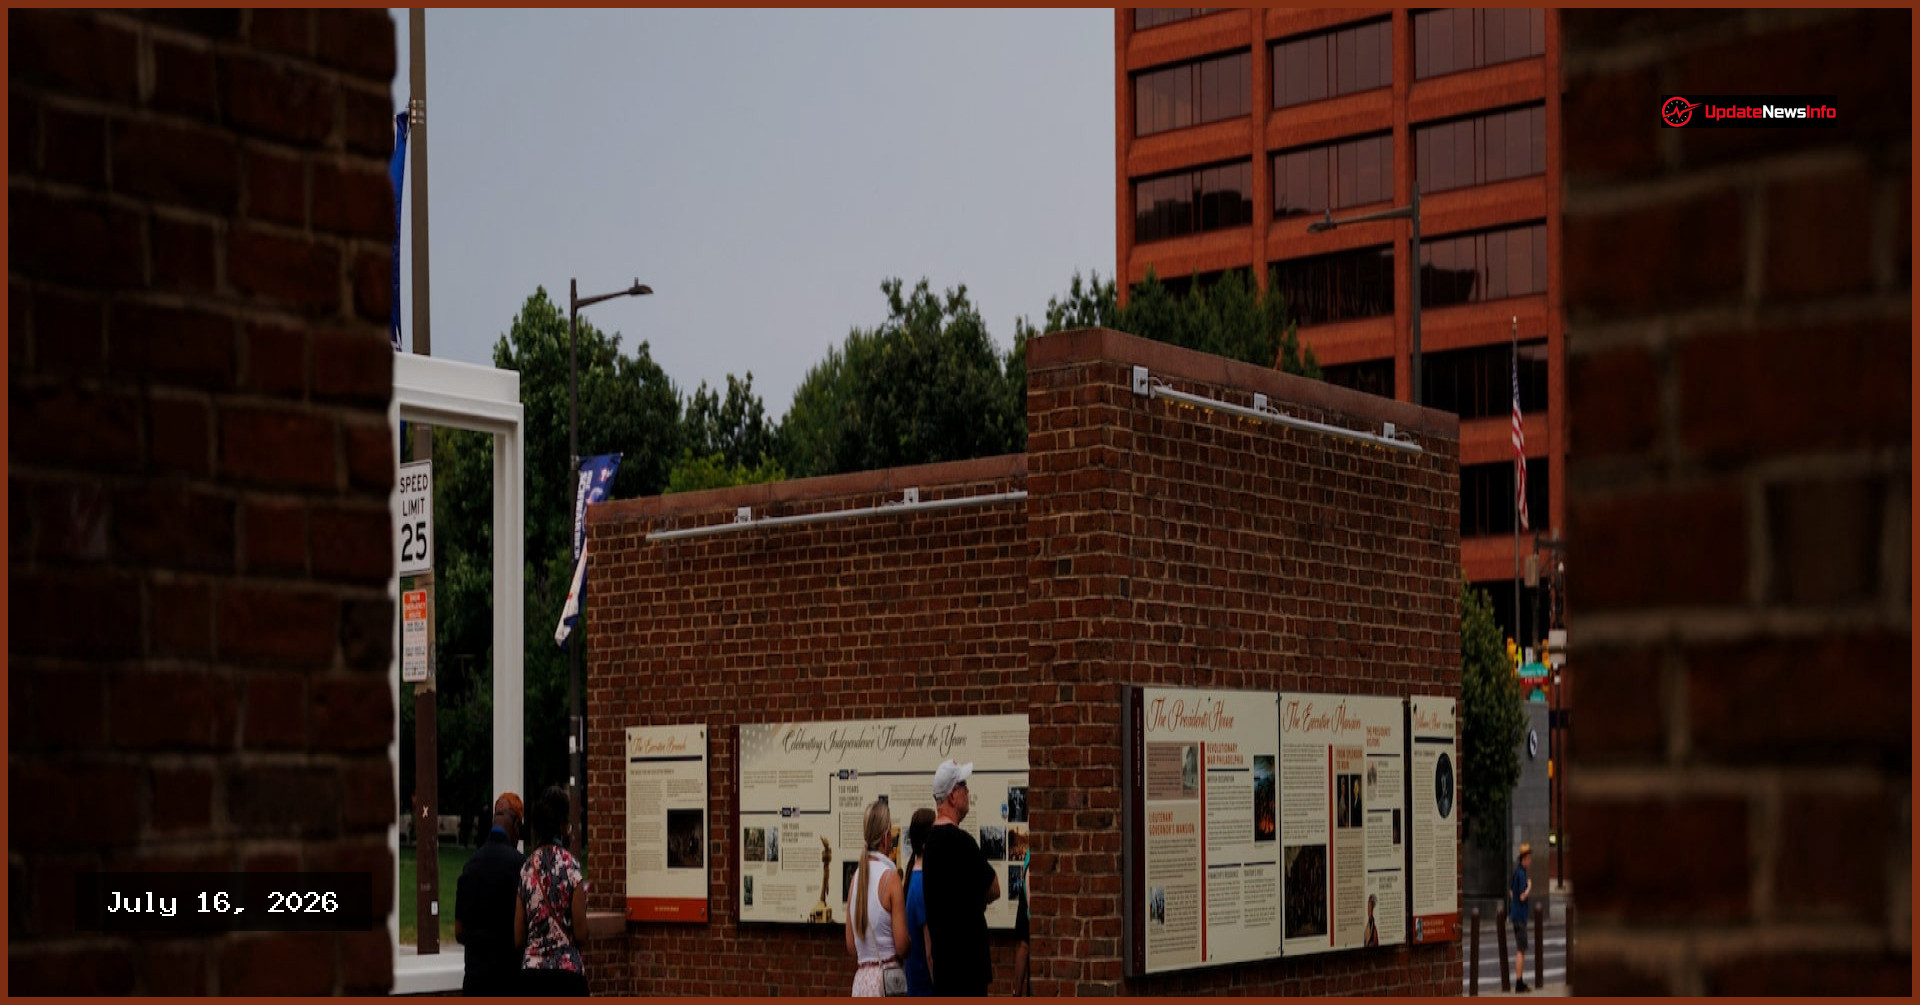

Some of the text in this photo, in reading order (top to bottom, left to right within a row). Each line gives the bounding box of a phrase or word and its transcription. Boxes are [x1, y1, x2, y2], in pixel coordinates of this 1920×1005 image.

[400, 473, 428, 493] SPEED
[402, 498, 425, 517] LIMIT
[401, 521, 427, 562] 25
[1146, 697, 1167, 732] The
[1208, 699, 1235, 732] House
[1282, 701, 1361, 734] The Executive Mansion
[782, 728, 822, 764] Celebrating
[823, 727, 875, 764] Independence
[877, 724, 925, 762] Throughout
[927, 724, 938, 747] the
[939, 722, 967, 758] Years
[1149, 811, 1173, 823] LIEUTENANT
[1175, 823, 1195, 835] MANSION
